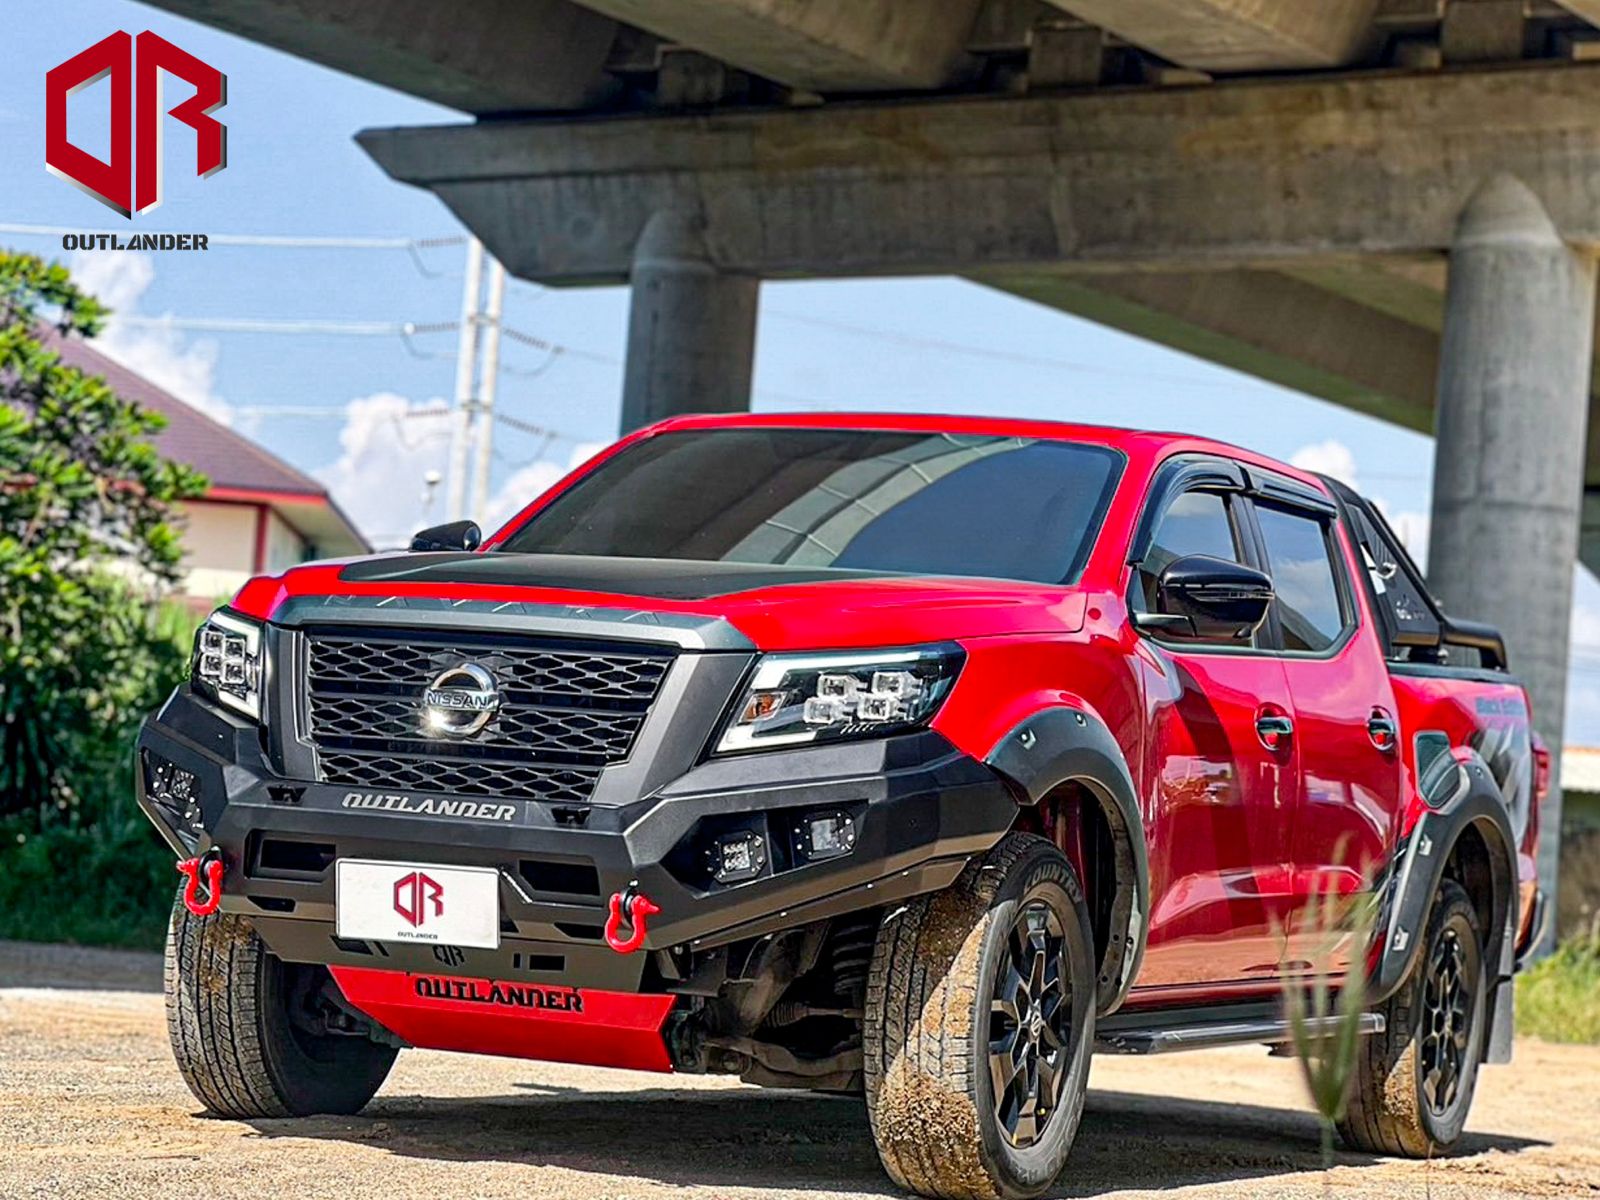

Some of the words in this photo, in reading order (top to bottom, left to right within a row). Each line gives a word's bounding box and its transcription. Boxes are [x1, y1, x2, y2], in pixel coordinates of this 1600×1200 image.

[324, 594, 661, 625] NAVARA
[427, 691, 487, 710] NISSAN
[342, 792, 516, 820] OUTLANDER
[398, 931, 438, 940] OUTLANDER
[415, 977, 584, 1013] OUTLANDER
